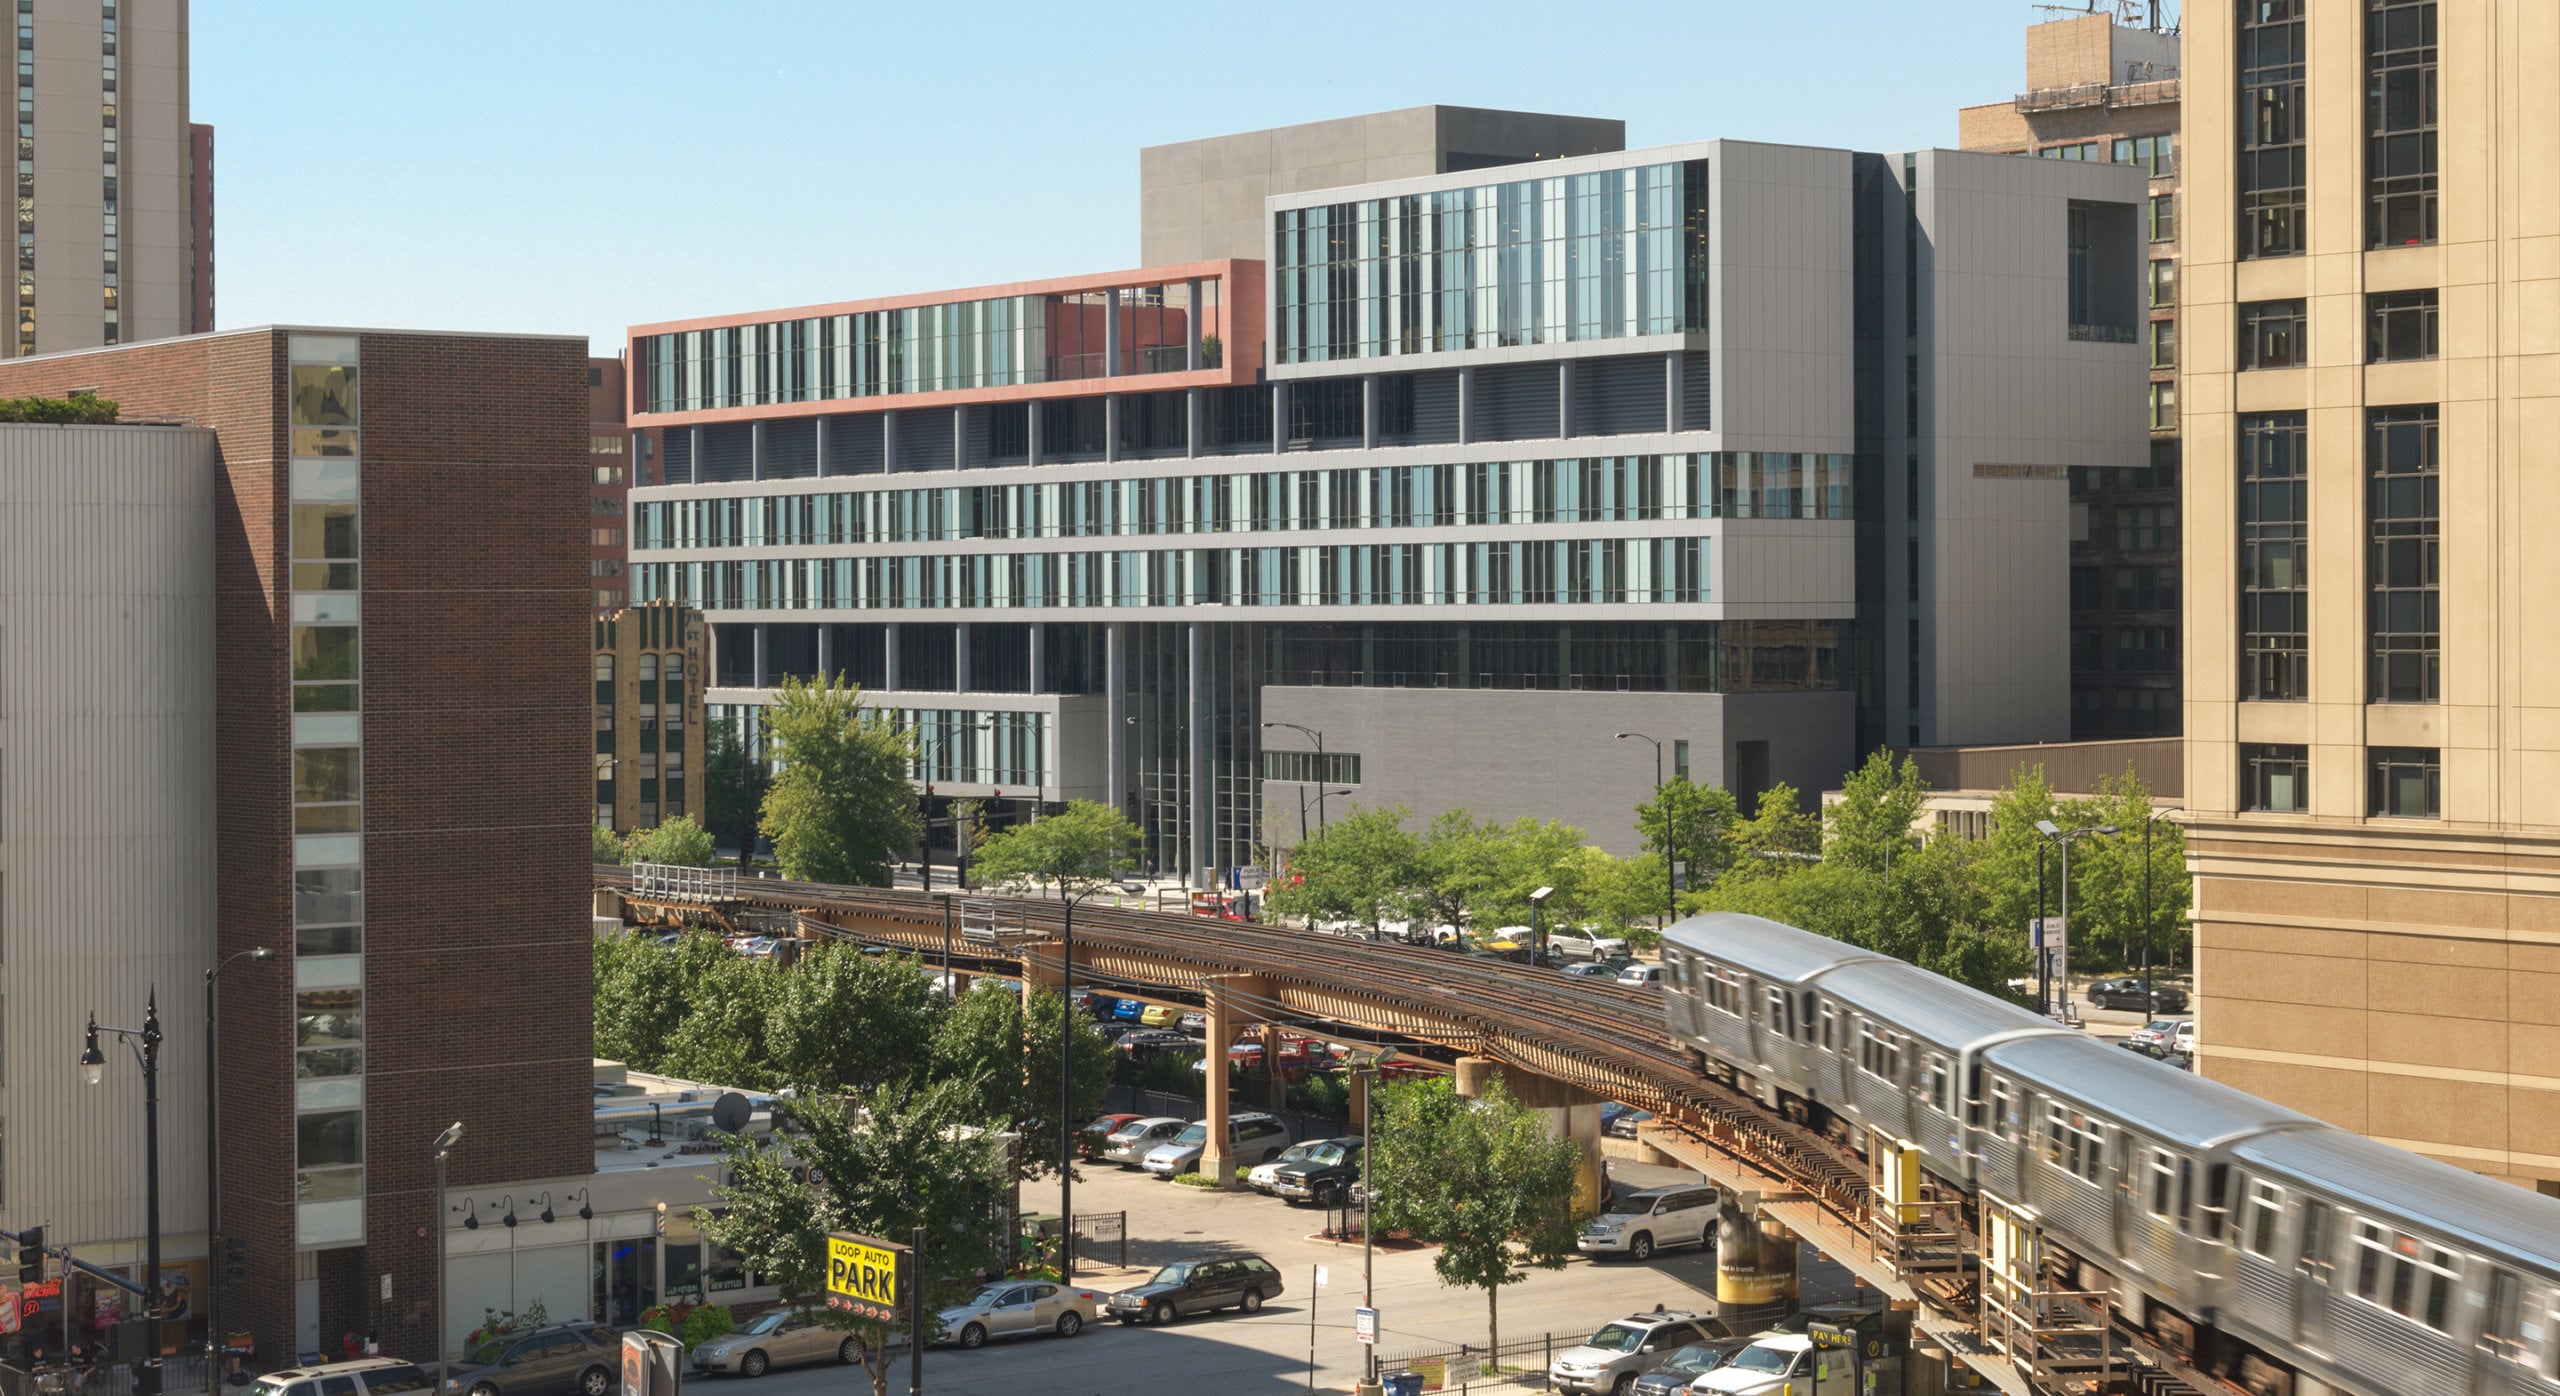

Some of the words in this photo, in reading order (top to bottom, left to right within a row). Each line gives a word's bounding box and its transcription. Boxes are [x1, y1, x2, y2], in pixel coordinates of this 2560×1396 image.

[687, 647, 699, 725] HOTEL
[811, 1169, 824, 1182] 99
[835, 1243, 861, 1258] LOOP
[864, 1250, 890, 1266] AUTO
[711, 1281, 723, 1290] NEW
[723, 1279, 743, 1289] STYLES
[832, 1257, 893, 1302] PARK
[1813, 1330, 1829, 1340] PAY
[1831, 1333, 1853, 1345] HERE
